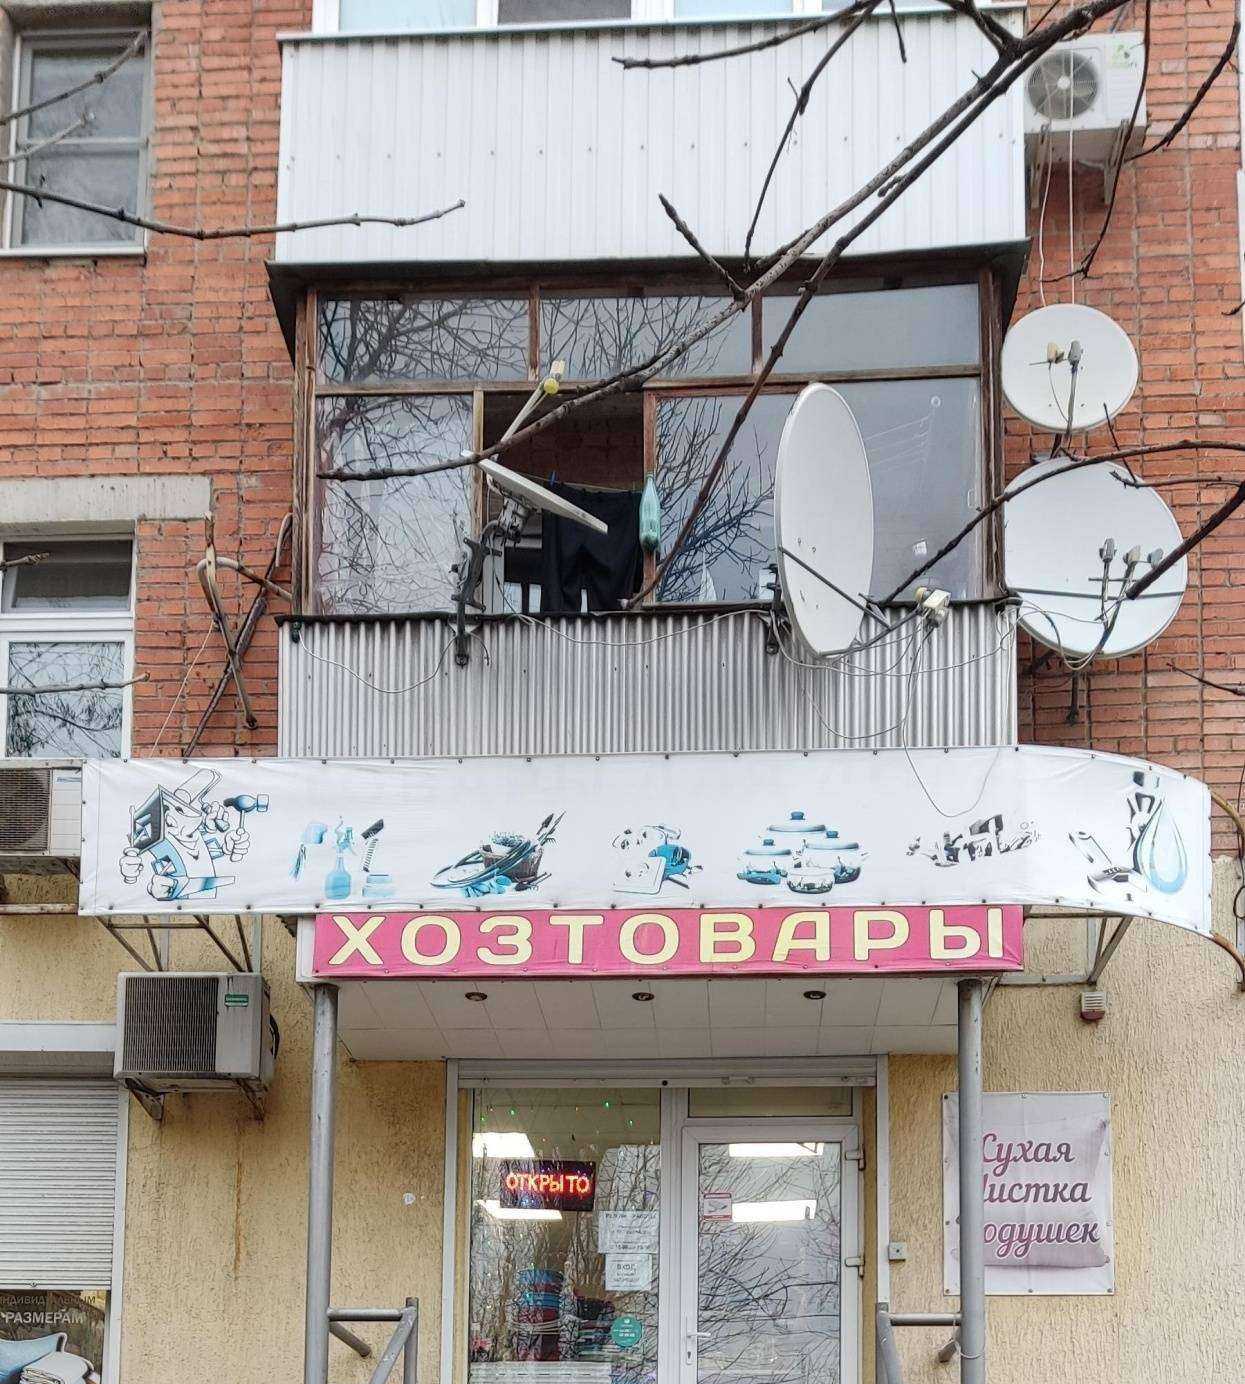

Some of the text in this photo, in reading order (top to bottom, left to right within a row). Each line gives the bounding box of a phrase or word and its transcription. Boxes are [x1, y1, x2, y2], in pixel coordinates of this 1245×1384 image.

[328, 907, 1004, 966] ХОЗТОВАРЫ
[983, 1133, 1075, 1177] Сухая
[506, 1172, 589, 1193] ОТКРЫТО
[983, 1222, 1100, 1257] одушек
[5, 1311, 84, 1324] РАЗМЕРАМ
